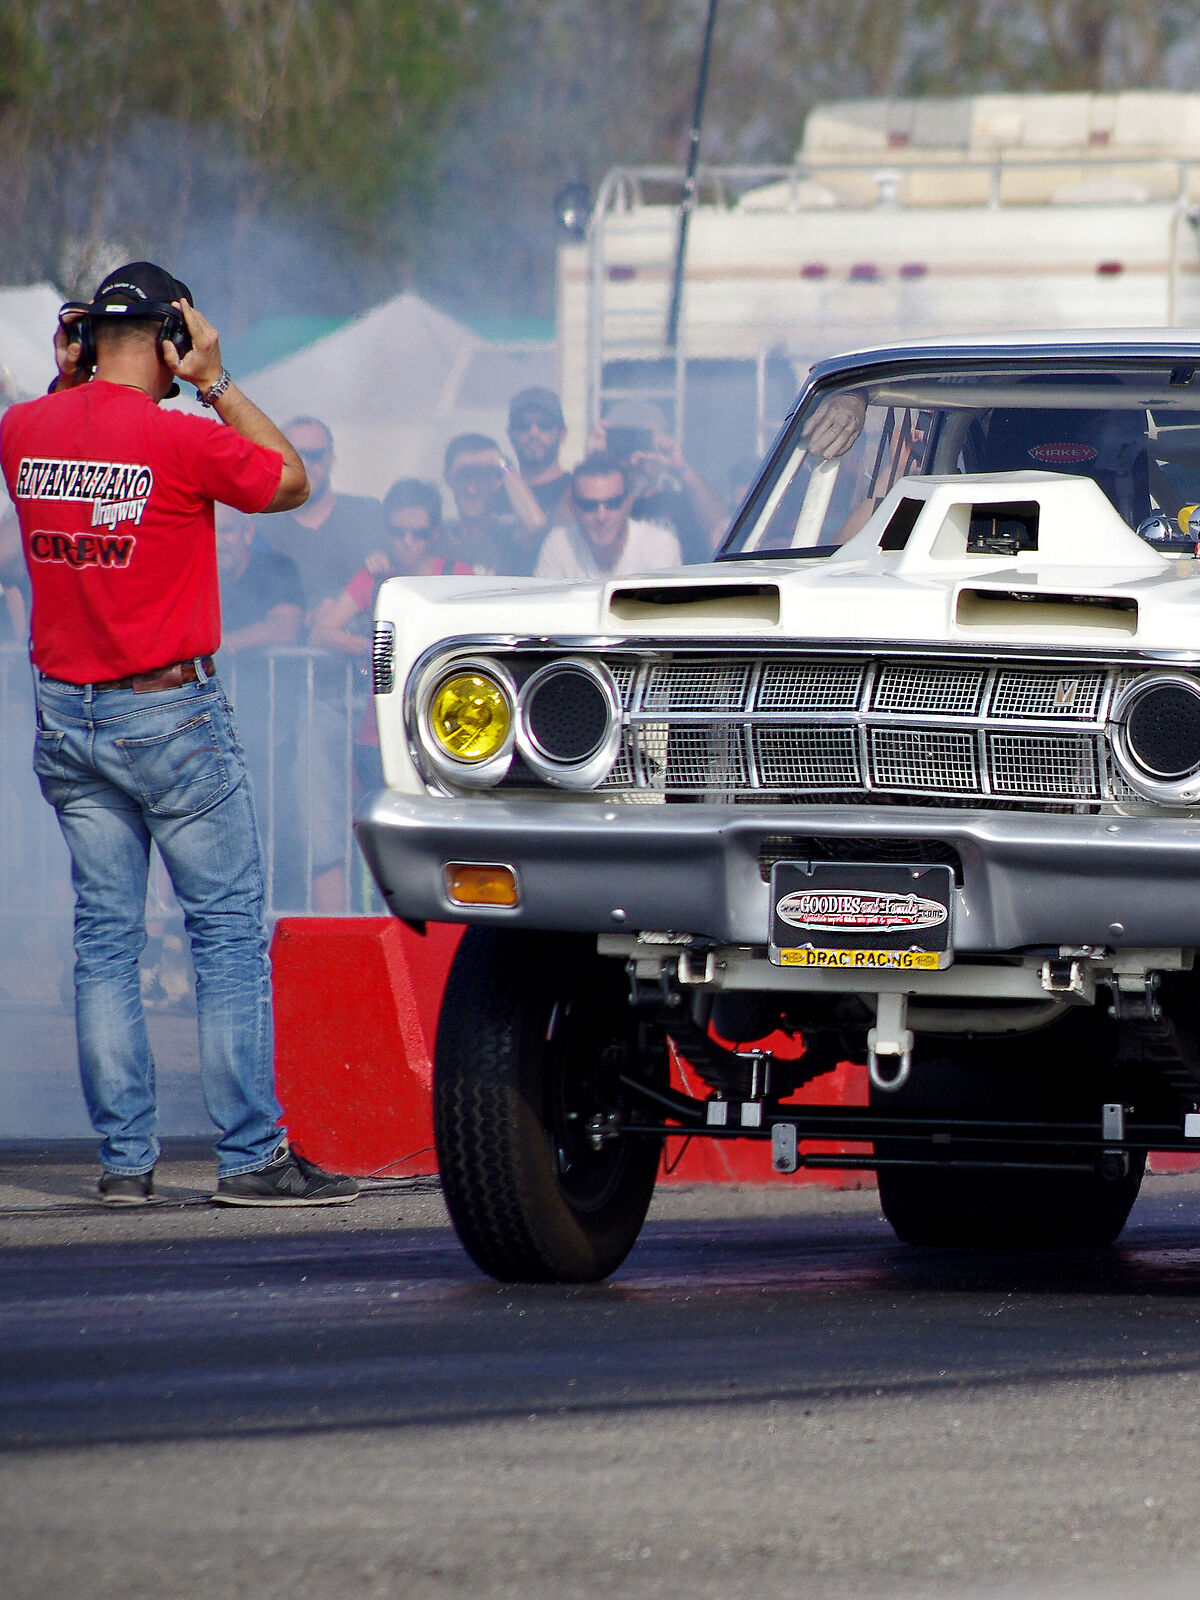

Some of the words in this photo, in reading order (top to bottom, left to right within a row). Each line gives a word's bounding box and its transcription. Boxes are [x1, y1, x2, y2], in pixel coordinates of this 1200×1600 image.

[1035, 449, 1091, 457] KIRKEY
[17, 459, 152, 500] RIVANAZZANO
[91, 497, 148, 530] Dragway
[31, 532, 134, 568] CREW
[800, 895, 862, 915] GOODIES
